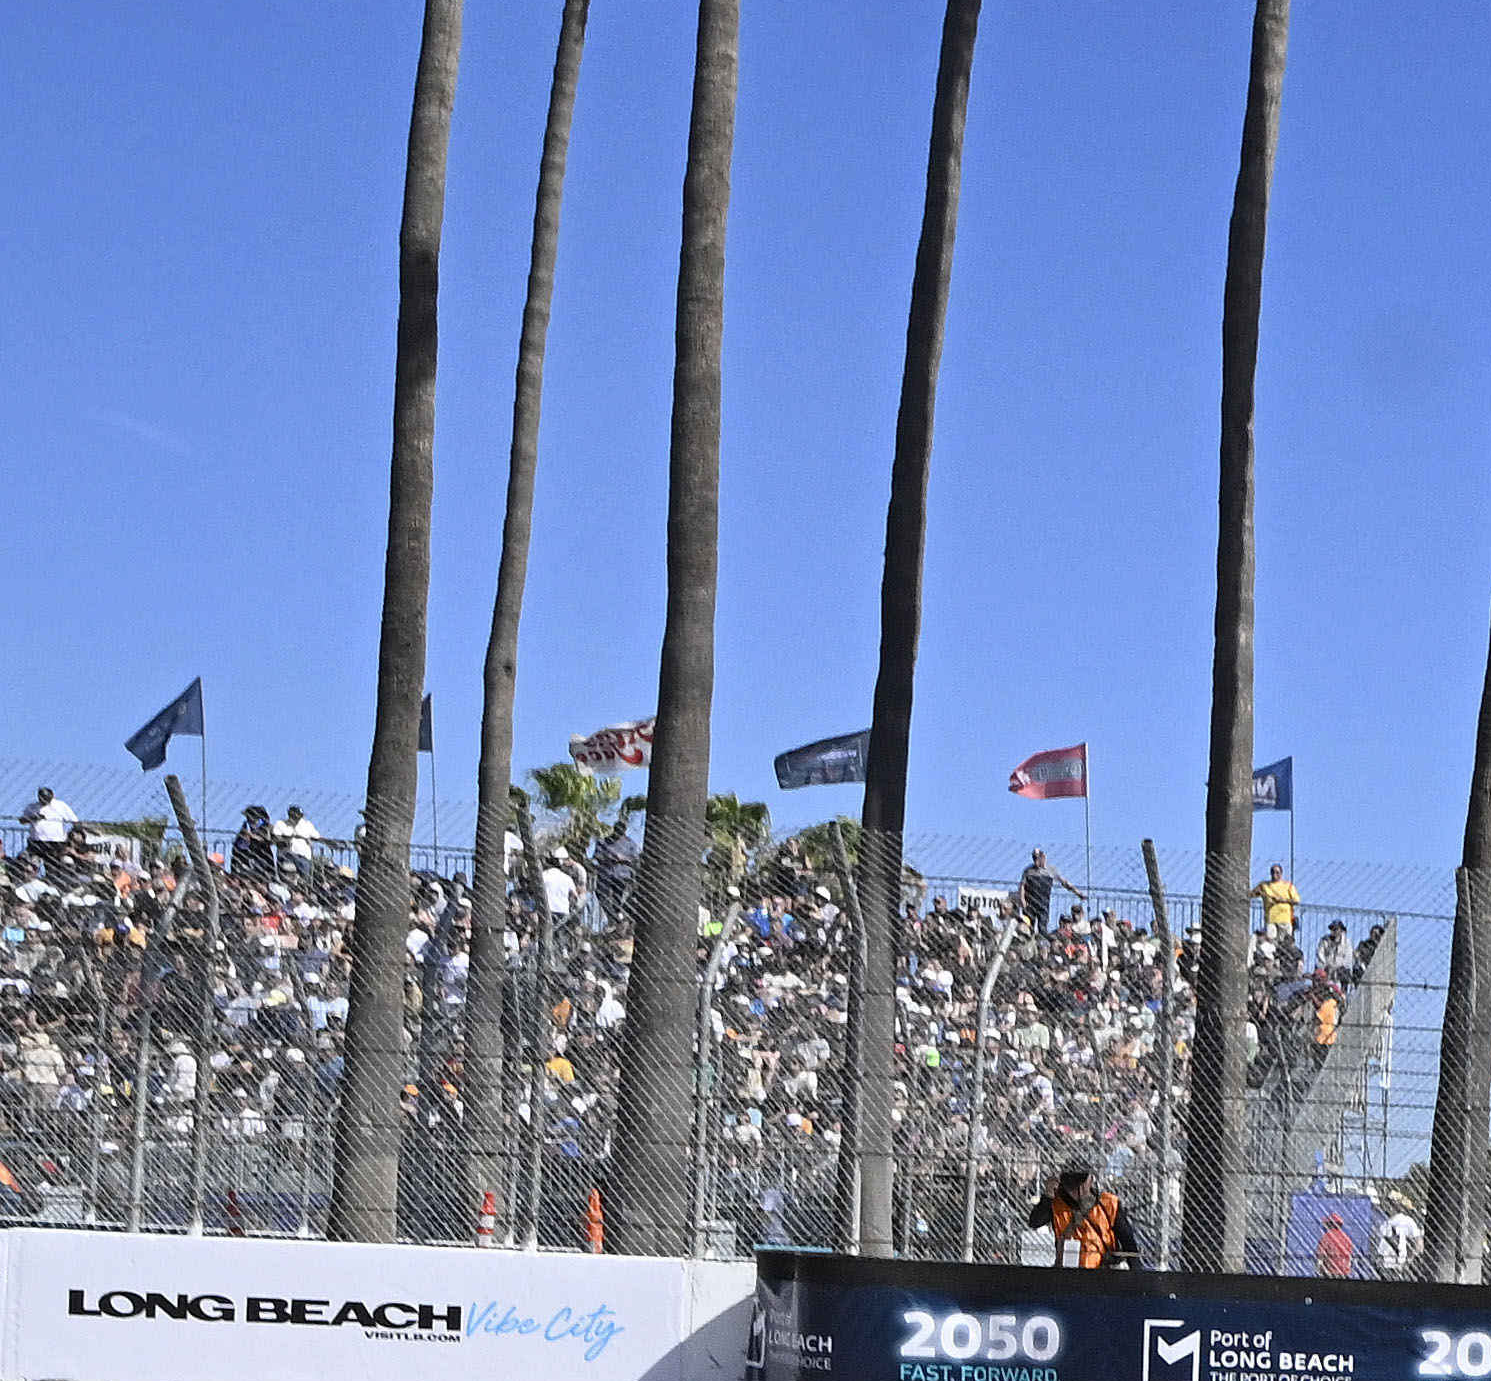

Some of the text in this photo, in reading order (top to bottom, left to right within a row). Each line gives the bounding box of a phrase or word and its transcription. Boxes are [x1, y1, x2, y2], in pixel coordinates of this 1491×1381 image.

[68, 1289, 624, 1361] LONG BEACH Vibe City
[901, 1311, 1060, 1361] 2050
[1210, 1330, 1272, 1349] Port of
[1209, 1351, 1354, 1372] LONG BEACH
